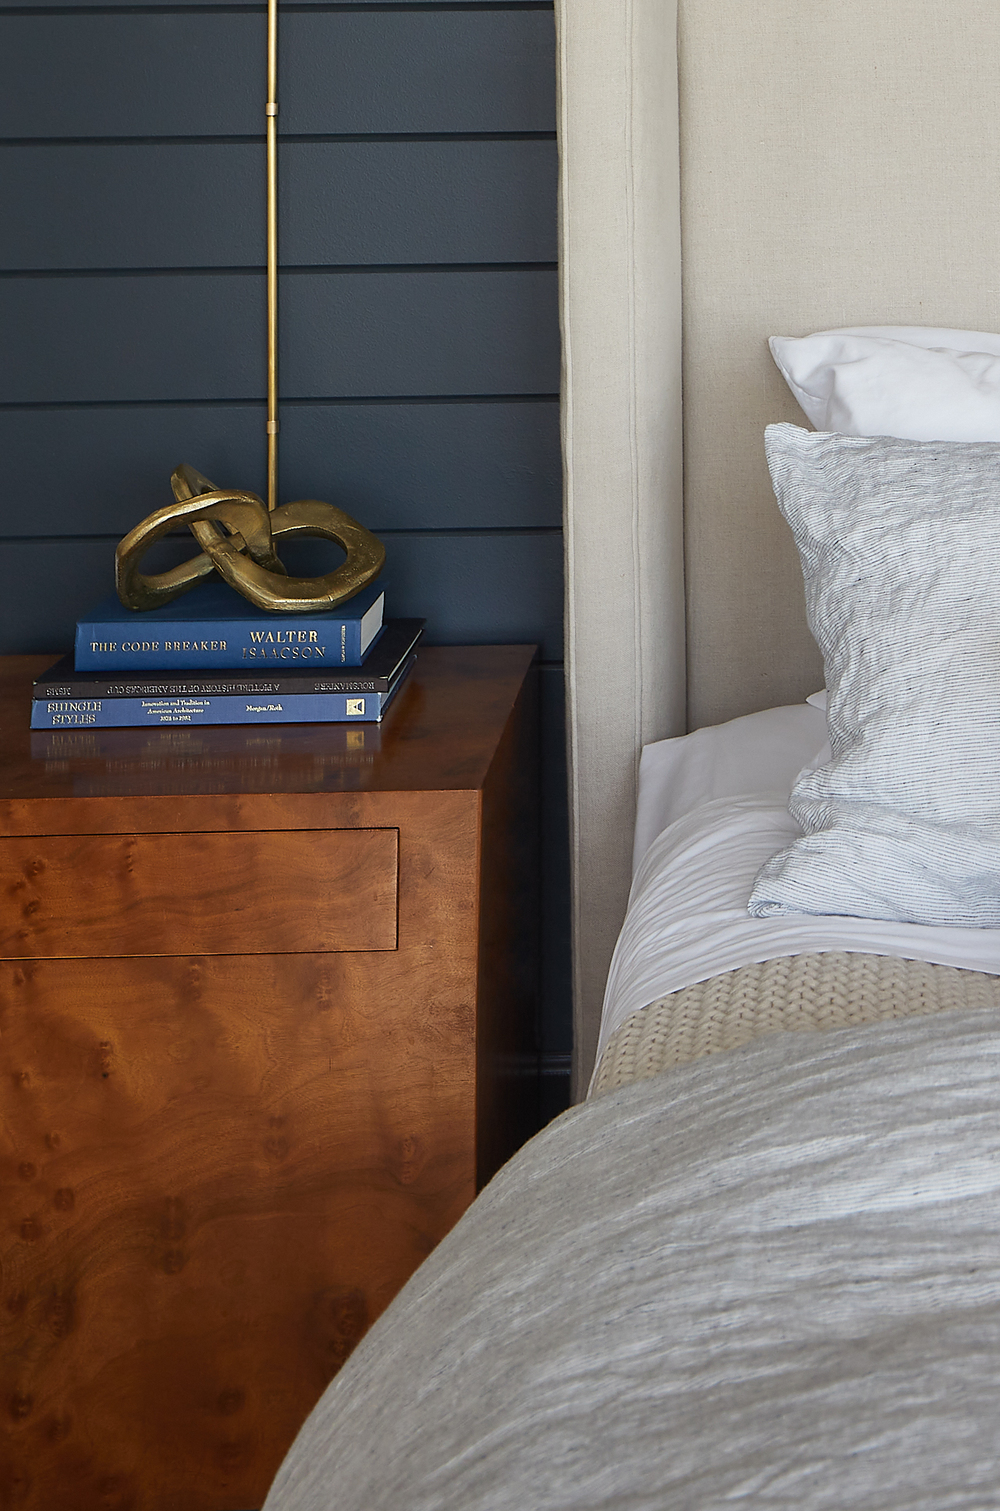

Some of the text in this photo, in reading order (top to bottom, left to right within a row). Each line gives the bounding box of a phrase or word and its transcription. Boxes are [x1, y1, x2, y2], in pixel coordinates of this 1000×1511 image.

[250, 630, 318, 643] WALTER
[90, 641, 228, 652] THE CODE BREAKER
[242, 647, 326, 659] ISAACSON
[107, 686, 124, 694] CUP
[188, 685, 200, 693] OF
[48, 701, 102, 713] SHINGLE
[53, 714, 96, 725] STYLES
